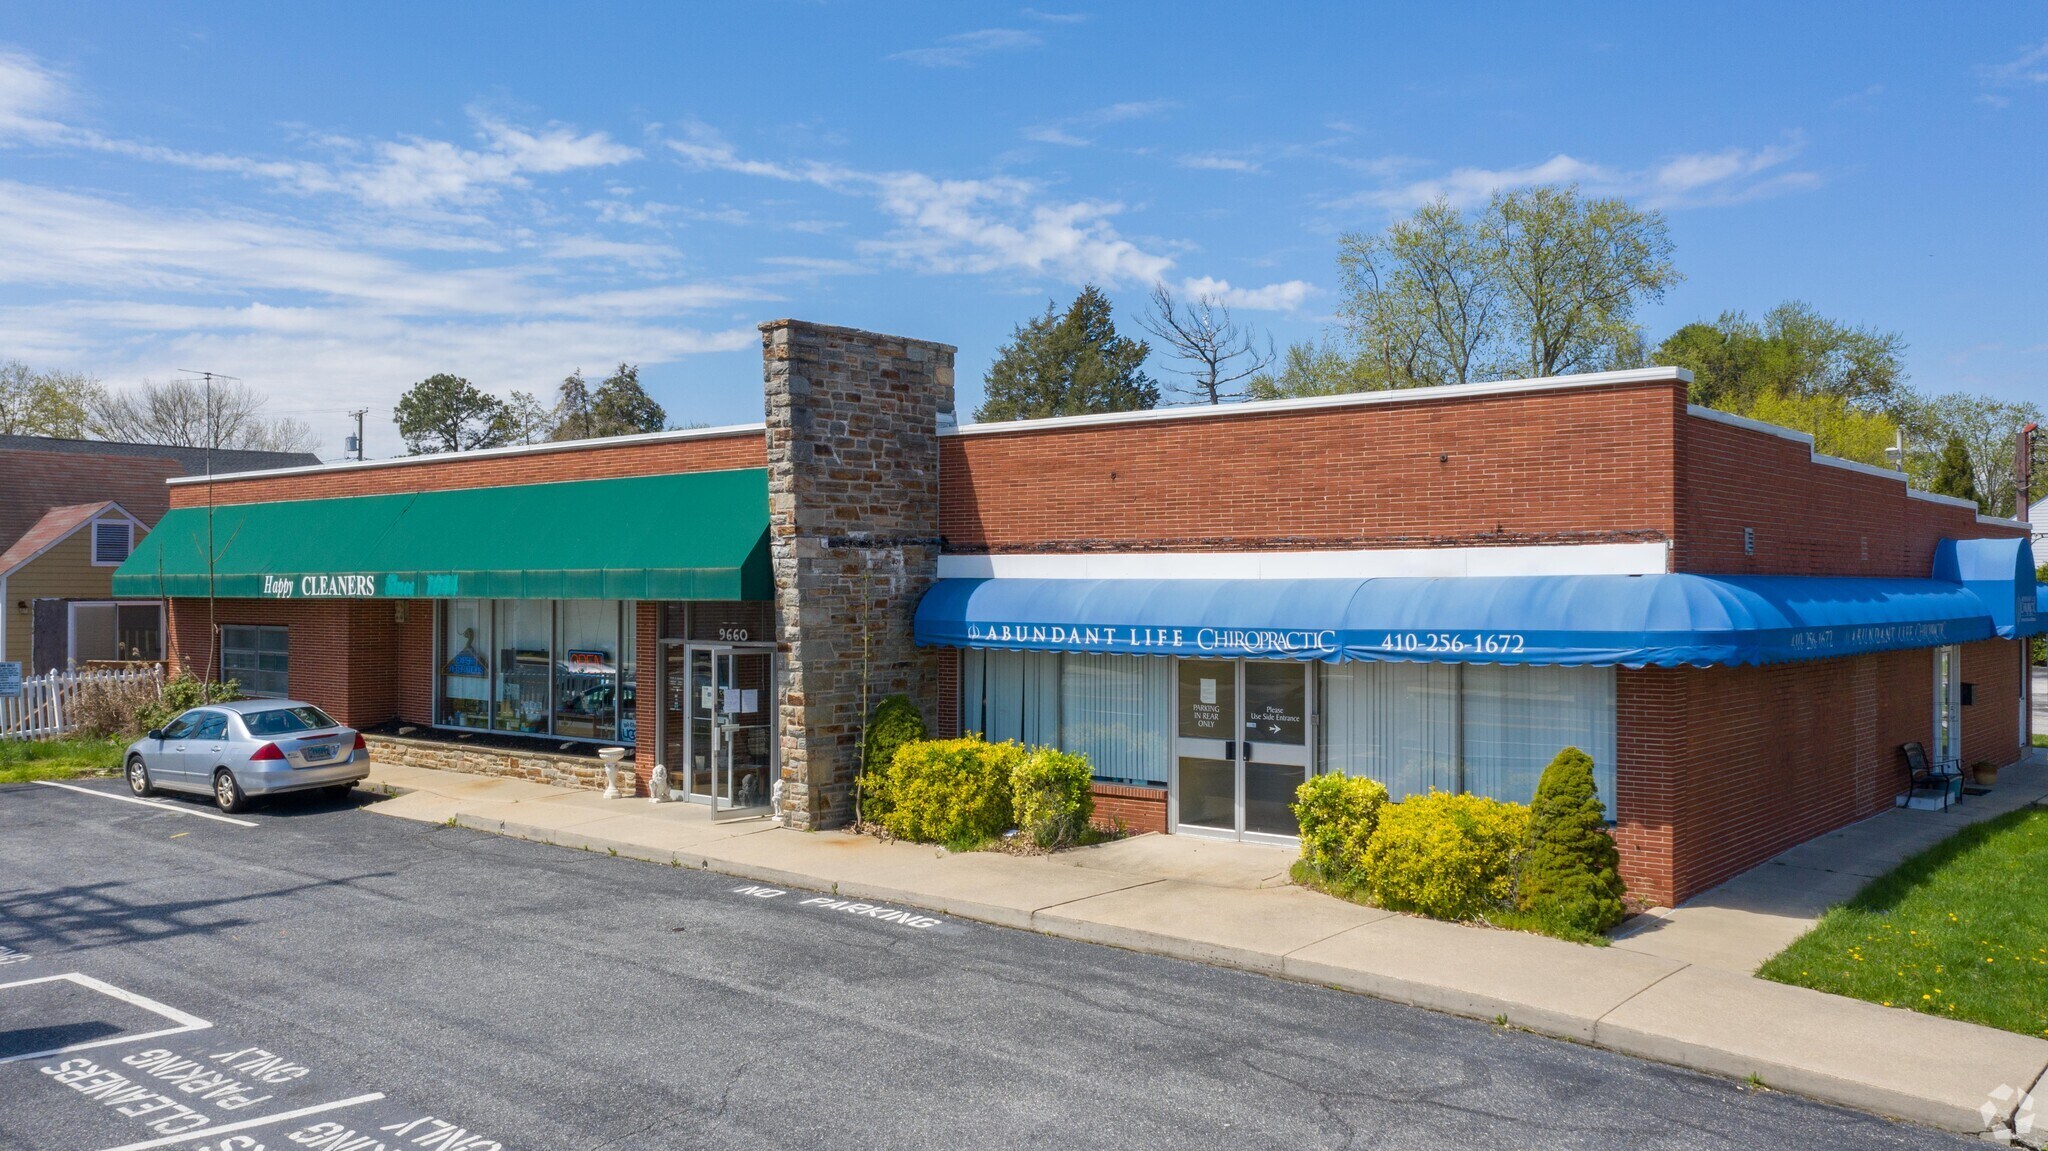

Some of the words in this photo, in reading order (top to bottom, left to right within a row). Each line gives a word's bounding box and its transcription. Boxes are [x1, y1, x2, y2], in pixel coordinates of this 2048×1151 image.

[264, 575, 293, 598] Happy
[302, 575, 375, 597] CLEANERS
[719, 628, 748, 641] 9660
[985, 625, 1116, 645] ABUNDANT
[1130, 628, 1183, 647] LIFE
[1197, 628, 1336, 654] CHIROPRACTIC
[1381, 633, 1525, 653] 410-256-1672
[570, 654, 603, 673] OPEN
[1193, 704, 1220, 713] PARKING
[1276, 714, 1300, 722] Entrance
[1198, 720, 1215, 728] ONLY
[734, 886, 787, 898] NO
[800, 897, 943, 928] PARKING
[209, 1047, 310, 1083] ONLY
[121, 1049, 274, 1110] PARKING
[40, 1058, 211, 1135] CLEANERS
